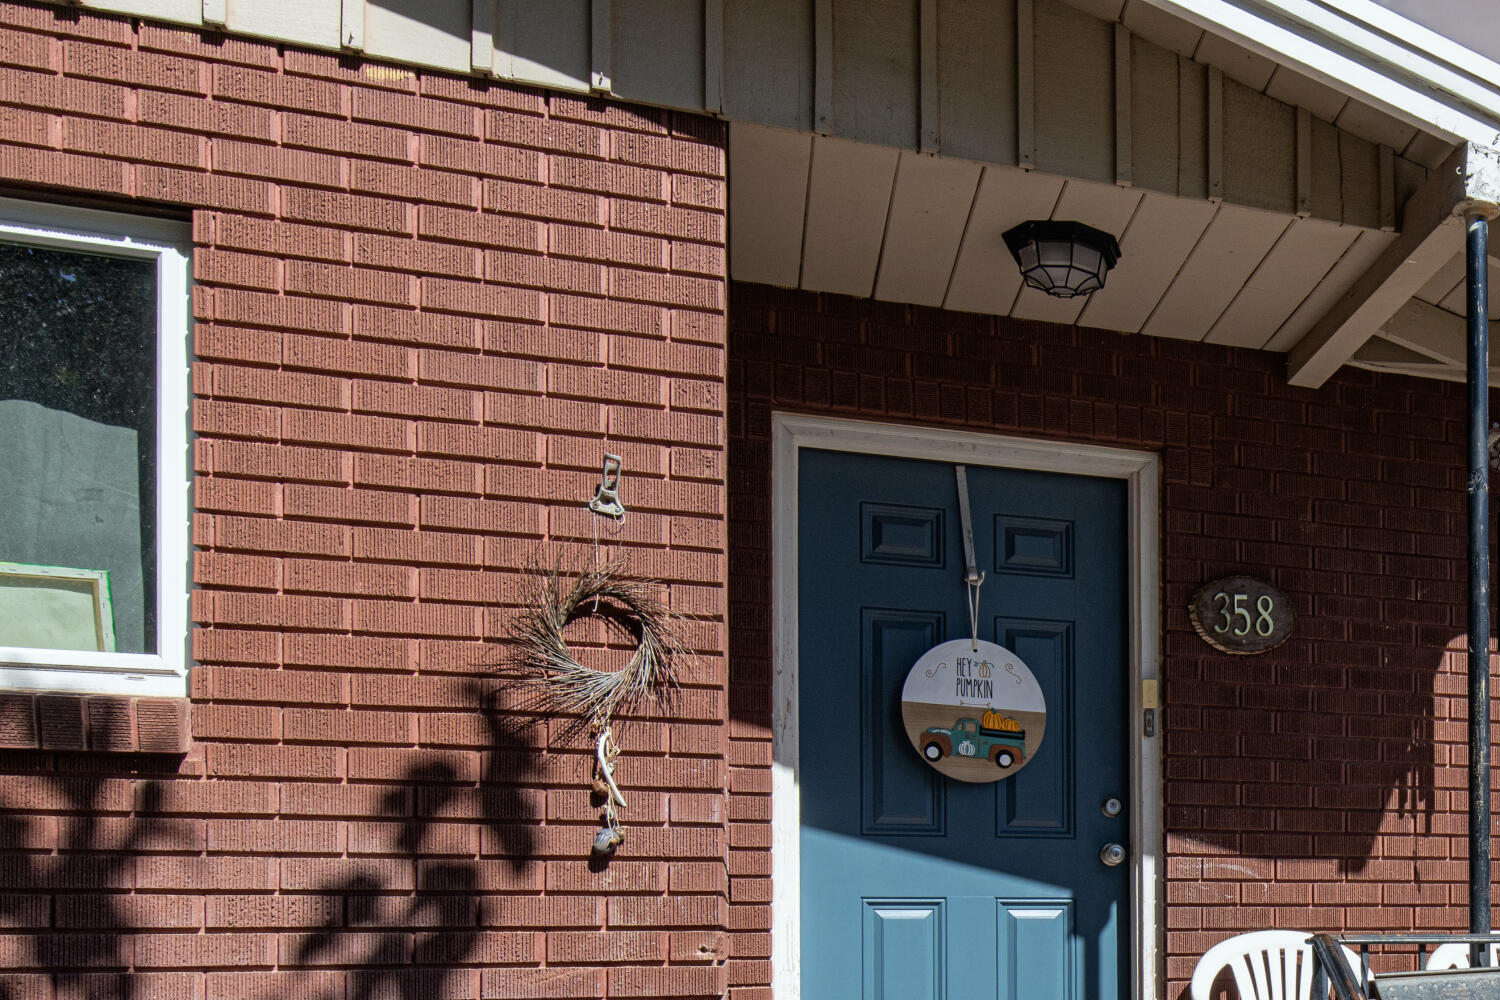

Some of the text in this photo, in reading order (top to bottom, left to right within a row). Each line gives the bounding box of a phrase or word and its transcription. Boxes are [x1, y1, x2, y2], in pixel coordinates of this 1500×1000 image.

[1214, 592, 1274, 637] 358
[956, 657, 972, 677] HEY
[956, 678, 993, 699] PUMPKIN
